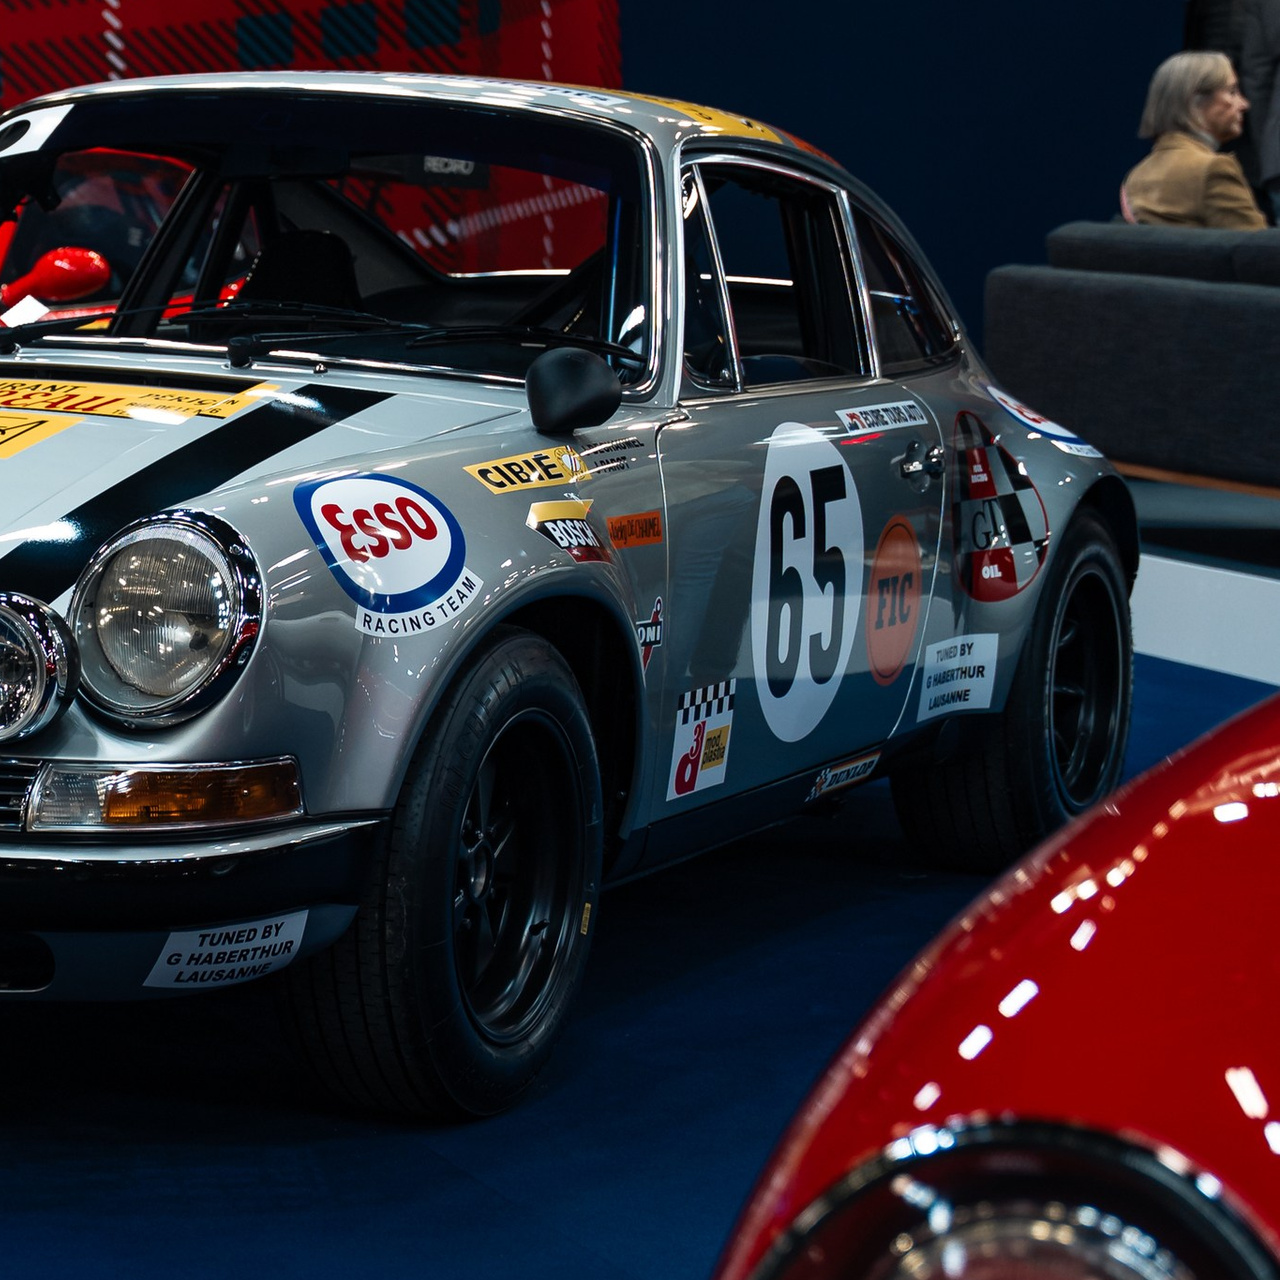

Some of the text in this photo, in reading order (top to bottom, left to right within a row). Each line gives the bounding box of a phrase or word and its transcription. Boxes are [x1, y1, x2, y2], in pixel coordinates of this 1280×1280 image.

[544, 519, 600, 548] BOSCH
[766, 464, 847, 698] 65
[981, 564, 1002, 580] OIL
[362, 576, 477, 634] RACING TEAM
[875, 572, 913, 630] FIC
[936, 642, 974, 663] TUNED BY
[926, 665, 985, 689] G HABERTHUR
[928, 689, 971, 711] LAUSANNE
[826, 759, 875, 788] DUNLOP
[198, 922, 285, 947] TUNED BY
[166, 940, 294, 966] G HABERTHUR
[174, 962, 272, 983] LAUSANNE
